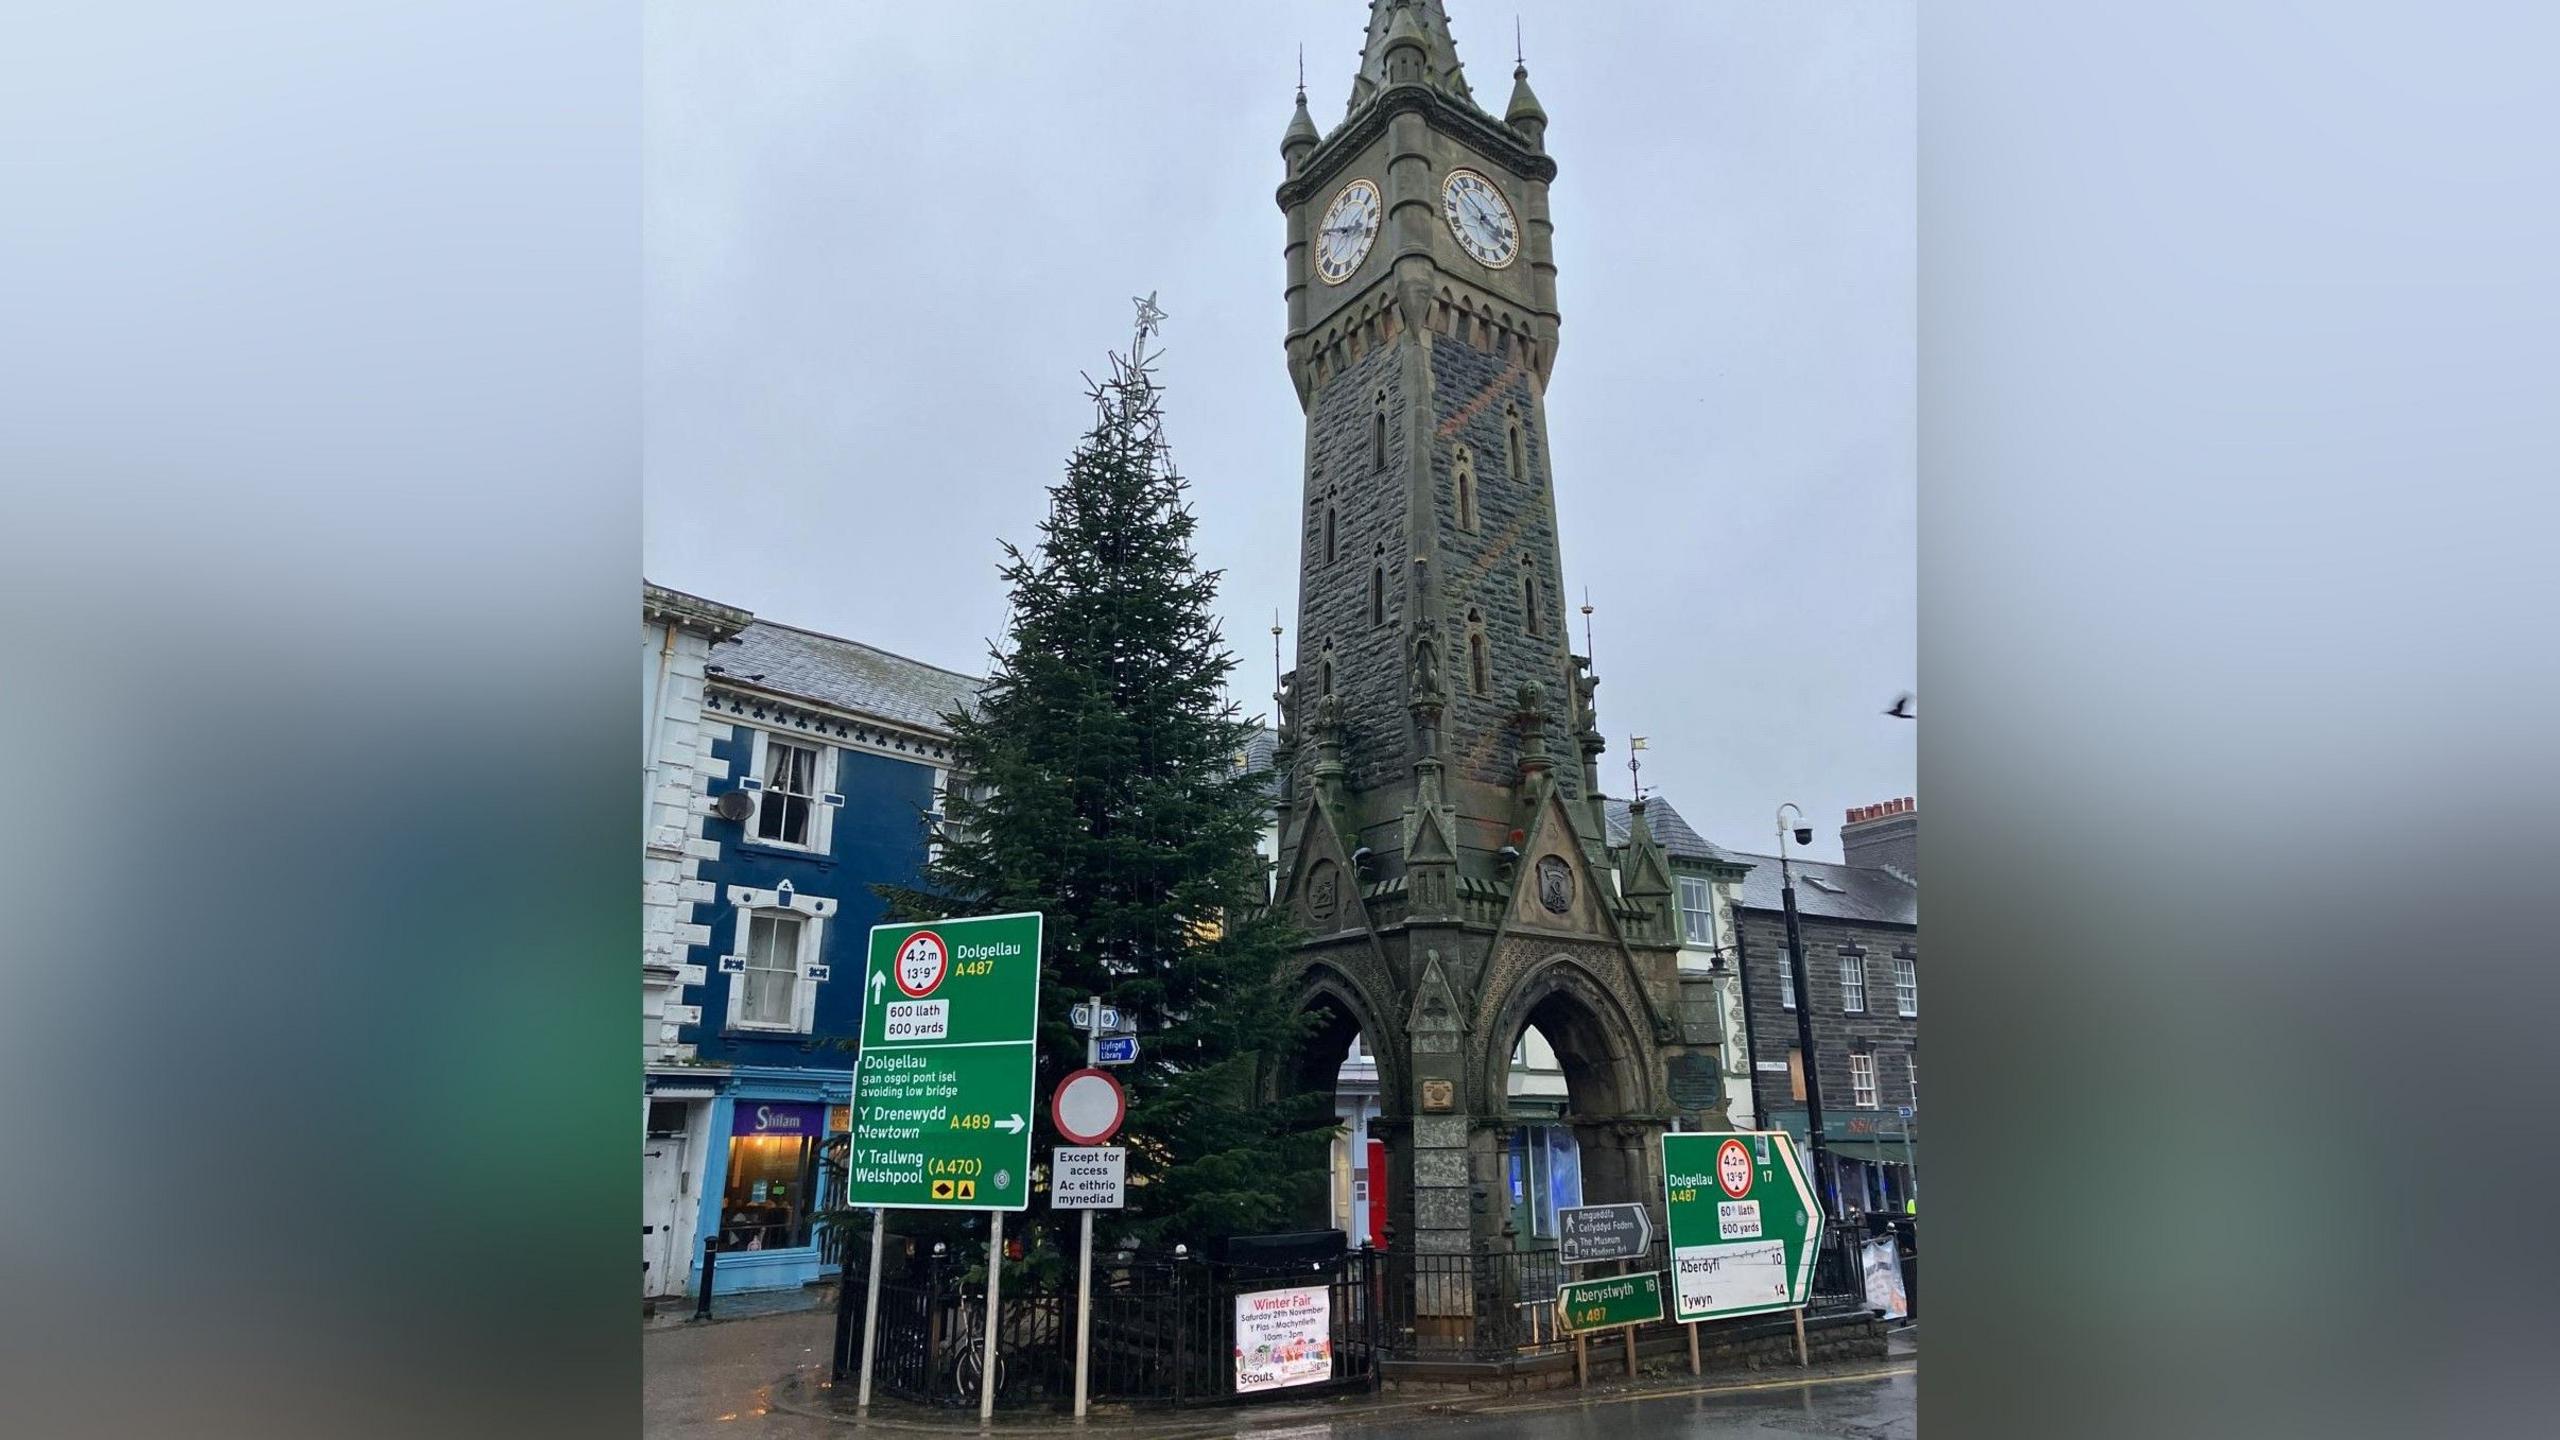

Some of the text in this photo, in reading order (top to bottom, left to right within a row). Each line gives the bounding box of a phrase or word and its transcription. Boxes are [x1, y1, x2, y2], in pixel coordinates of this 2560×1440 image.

[906, 949, 937, 962] 4.2 m
[957, 942, 1021, 960] Dolgellau
[890, 1004, 940, 1018] 600 llath
[889, 1022, 944, 1036] 600 yards
[865, 1054, 927, 1071] Dolgellau
[1101, 1051, 1122, 1060] Library
[862, 1071, 956, 1086] gan osgoi pont isel
[861, 1085, 958, 1099] avoiding low bridge
[755, 1105, 800, 1131] Shilam
[859, 1107, 870, 1120] Y
[874, 1106, 947, 1123] Drenewydd
[858, 1124, 920, 1139] Newtown
[856, 1149, 923, 1167] Y Trallwng
[1060, 1152, 1120, 1163] Except for
[1723, 1154, 1738, 1167] 4.2
[856, 1167, 923, 1185] Welshpool
[1070, 1167, 1108, 1175] access
[1763, 1170, 1772, 1183] 17
[1060, 1181, 1116, 1190] Ac eithrio
[1669, 1173, 1713, 1189] Dolgellau
[1058, 1193, 1114, 1206] mynediad
[1738, 1205, 1755, 1216] llath
[1722, 1223, 1760, 1235] 600 yards
[1580, 1235, 1621, 1246] The Museum
[1680, 1252, 1782, 1274] Aberdyfi 10
[1575, 1280, 1656, 1303] Aberystwyth 18
[1682, 1284, 1786, 1308] Tywyn 14
[1254, 1295, 1312, 1311] Winter Fair
[1241, 1312, 1272, 1322] Saturday
[1289, 1306, 1323, 1316] November
[1250, 1324, 1254, 1332] Y
[1256, 1323, 1270, 1331] Plas
[1264, 1333, 1283, 1341] 10am
[1289, 1331, 1303, 1339] 3pm
[1240, 1372, 1274, 1385] Scouts
